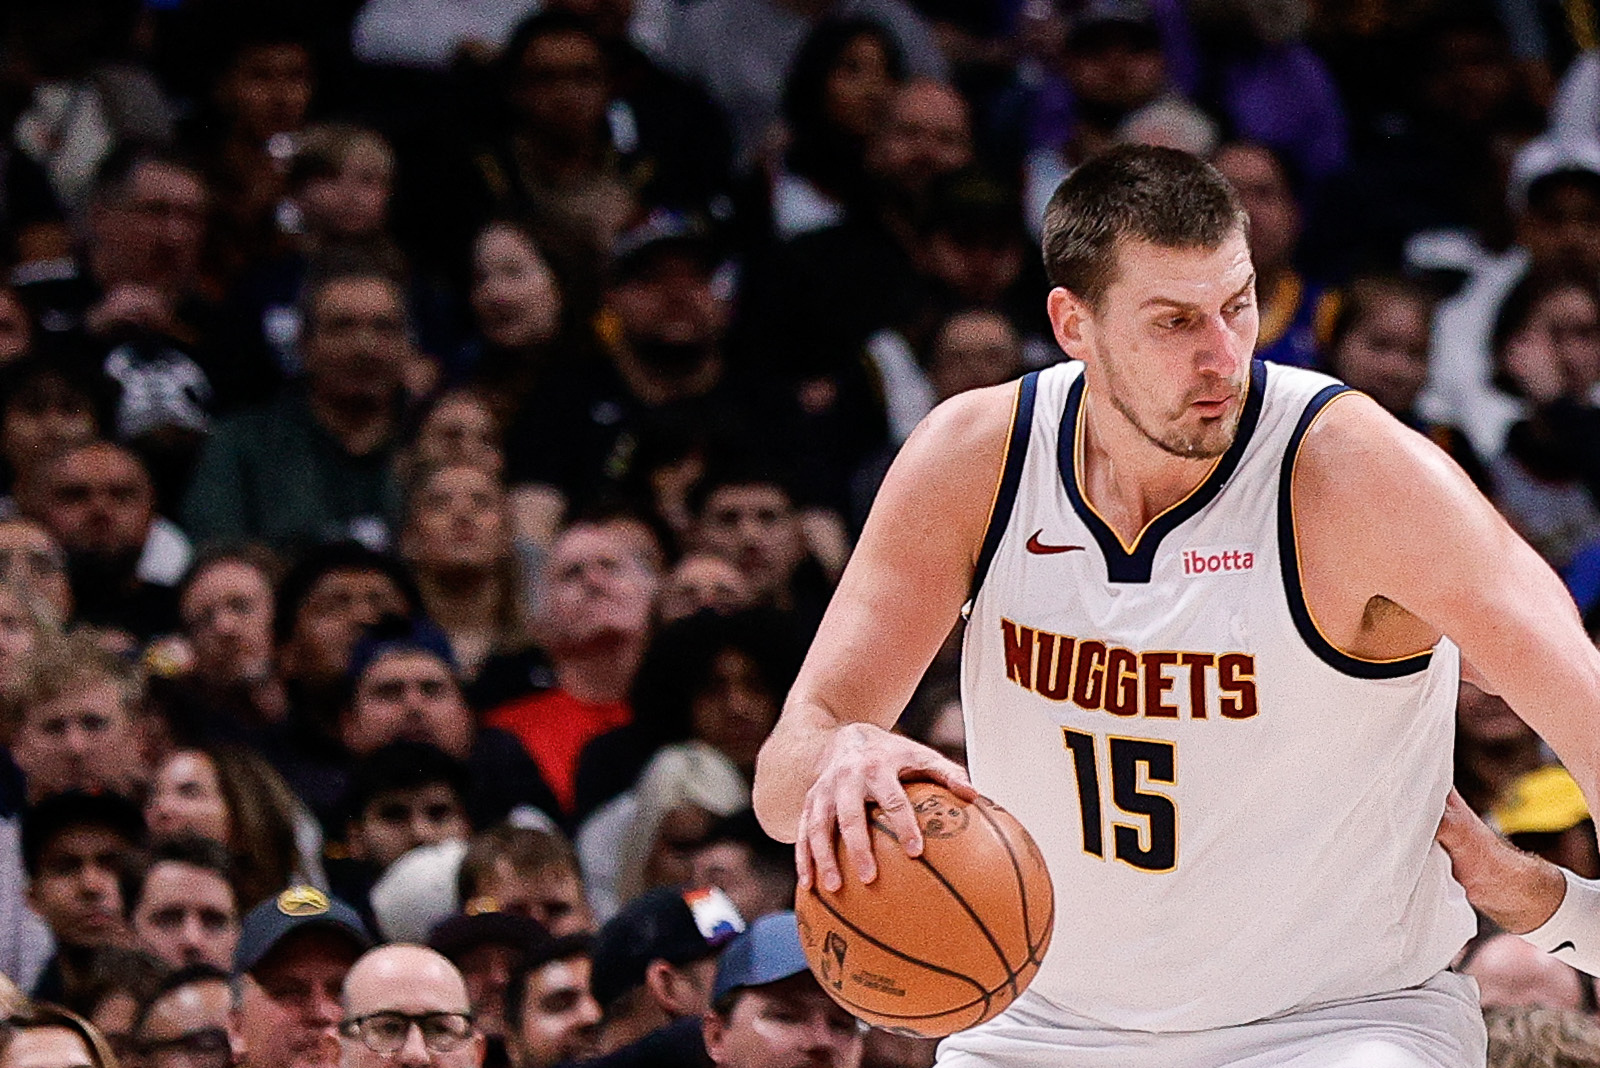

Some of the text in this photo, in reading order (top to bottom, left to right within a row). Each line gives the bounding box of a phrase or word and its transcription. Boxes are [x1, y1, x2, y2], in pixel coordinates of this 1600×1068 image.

[1183, 550, 1254, 575] ibotta
[1000, 617, 1259, 720] NUGGETS
[1061, 726, 1179, 874] 15
